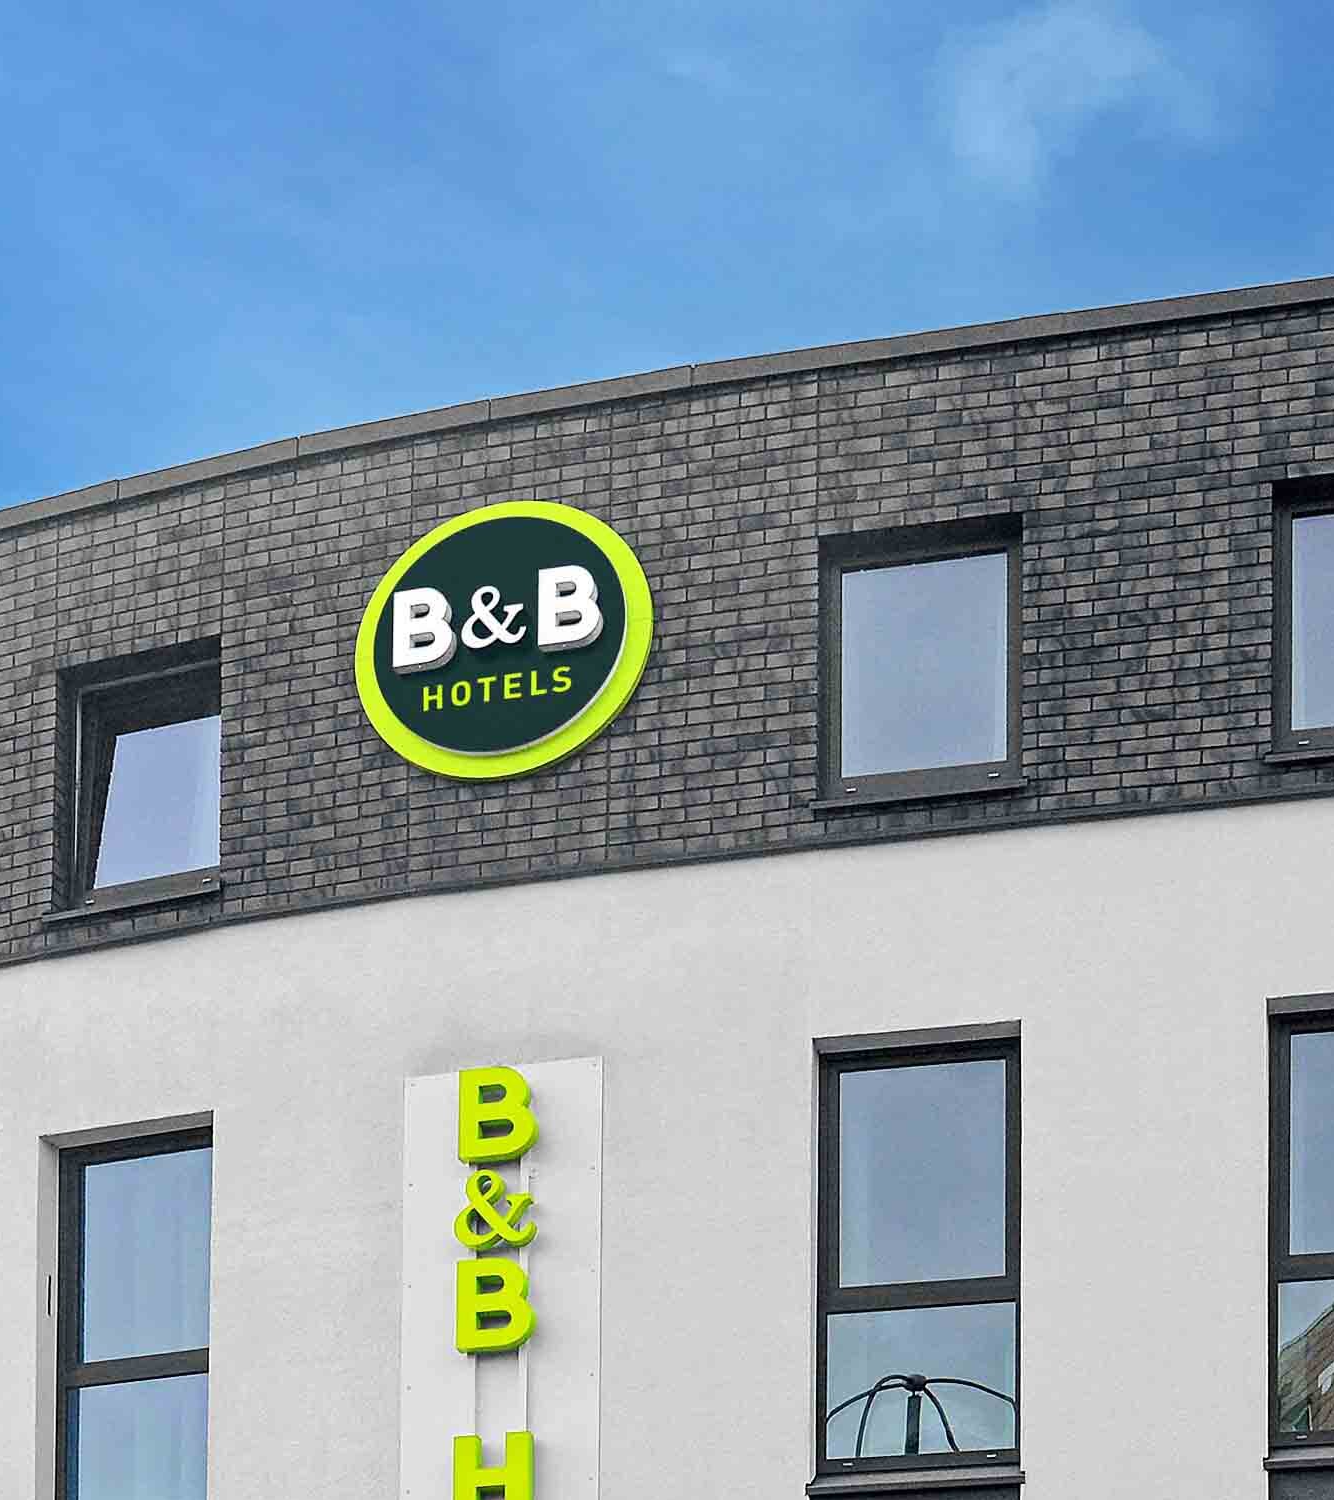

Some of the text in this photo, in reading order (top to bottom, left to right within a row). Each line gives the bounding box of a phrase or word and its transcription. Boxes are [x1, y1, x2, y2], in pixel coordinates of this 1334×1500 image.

[391, 563, 604, 675] B&B
[422, 665, 573, 713] HOTELS
[454, 1066, 540, 1355] B&B
